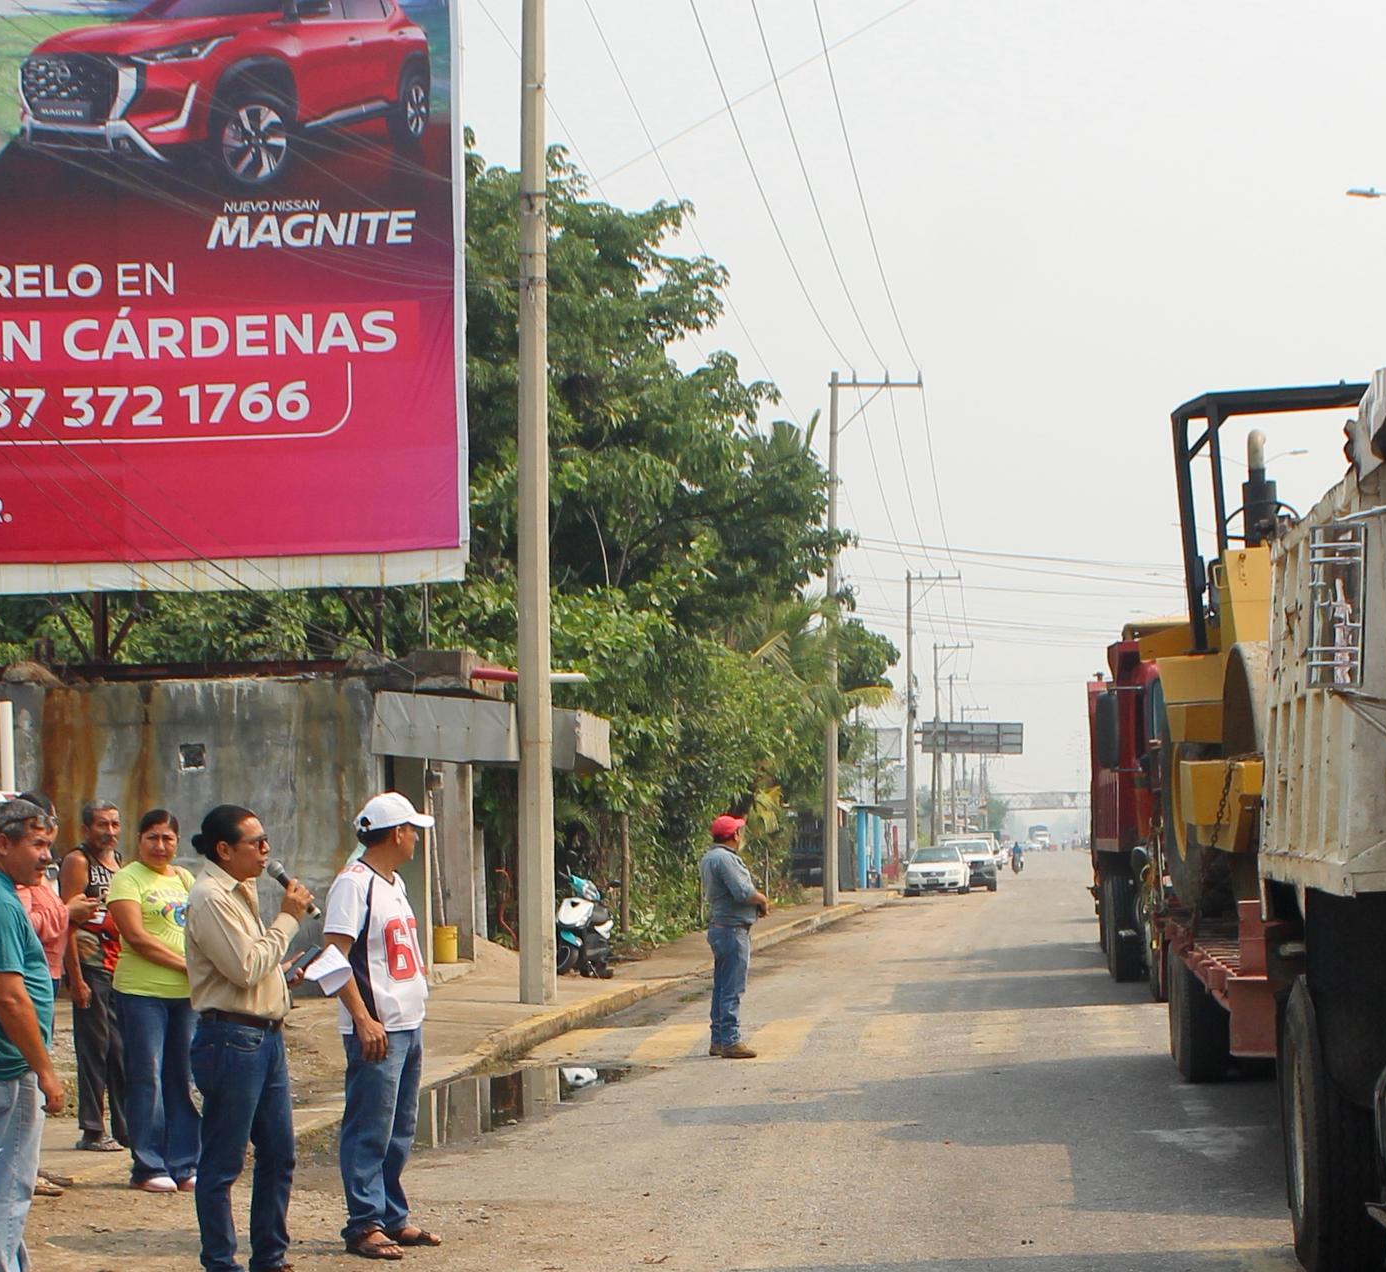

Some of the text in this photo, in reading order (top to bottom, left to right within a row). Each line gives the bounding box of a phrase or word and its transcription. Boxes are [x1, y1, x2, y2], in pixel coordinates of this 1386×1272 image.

[223, 199, 320, 213] NUEVO NISSAN
[206, 209, 416, 250] MAGNITE
[117, 262, 175, 296] EN
[63, 307, 397, 361] CÁRDENAS
[63, 385, 164, 427] 372
[179, 381, 310, 424] 1766
